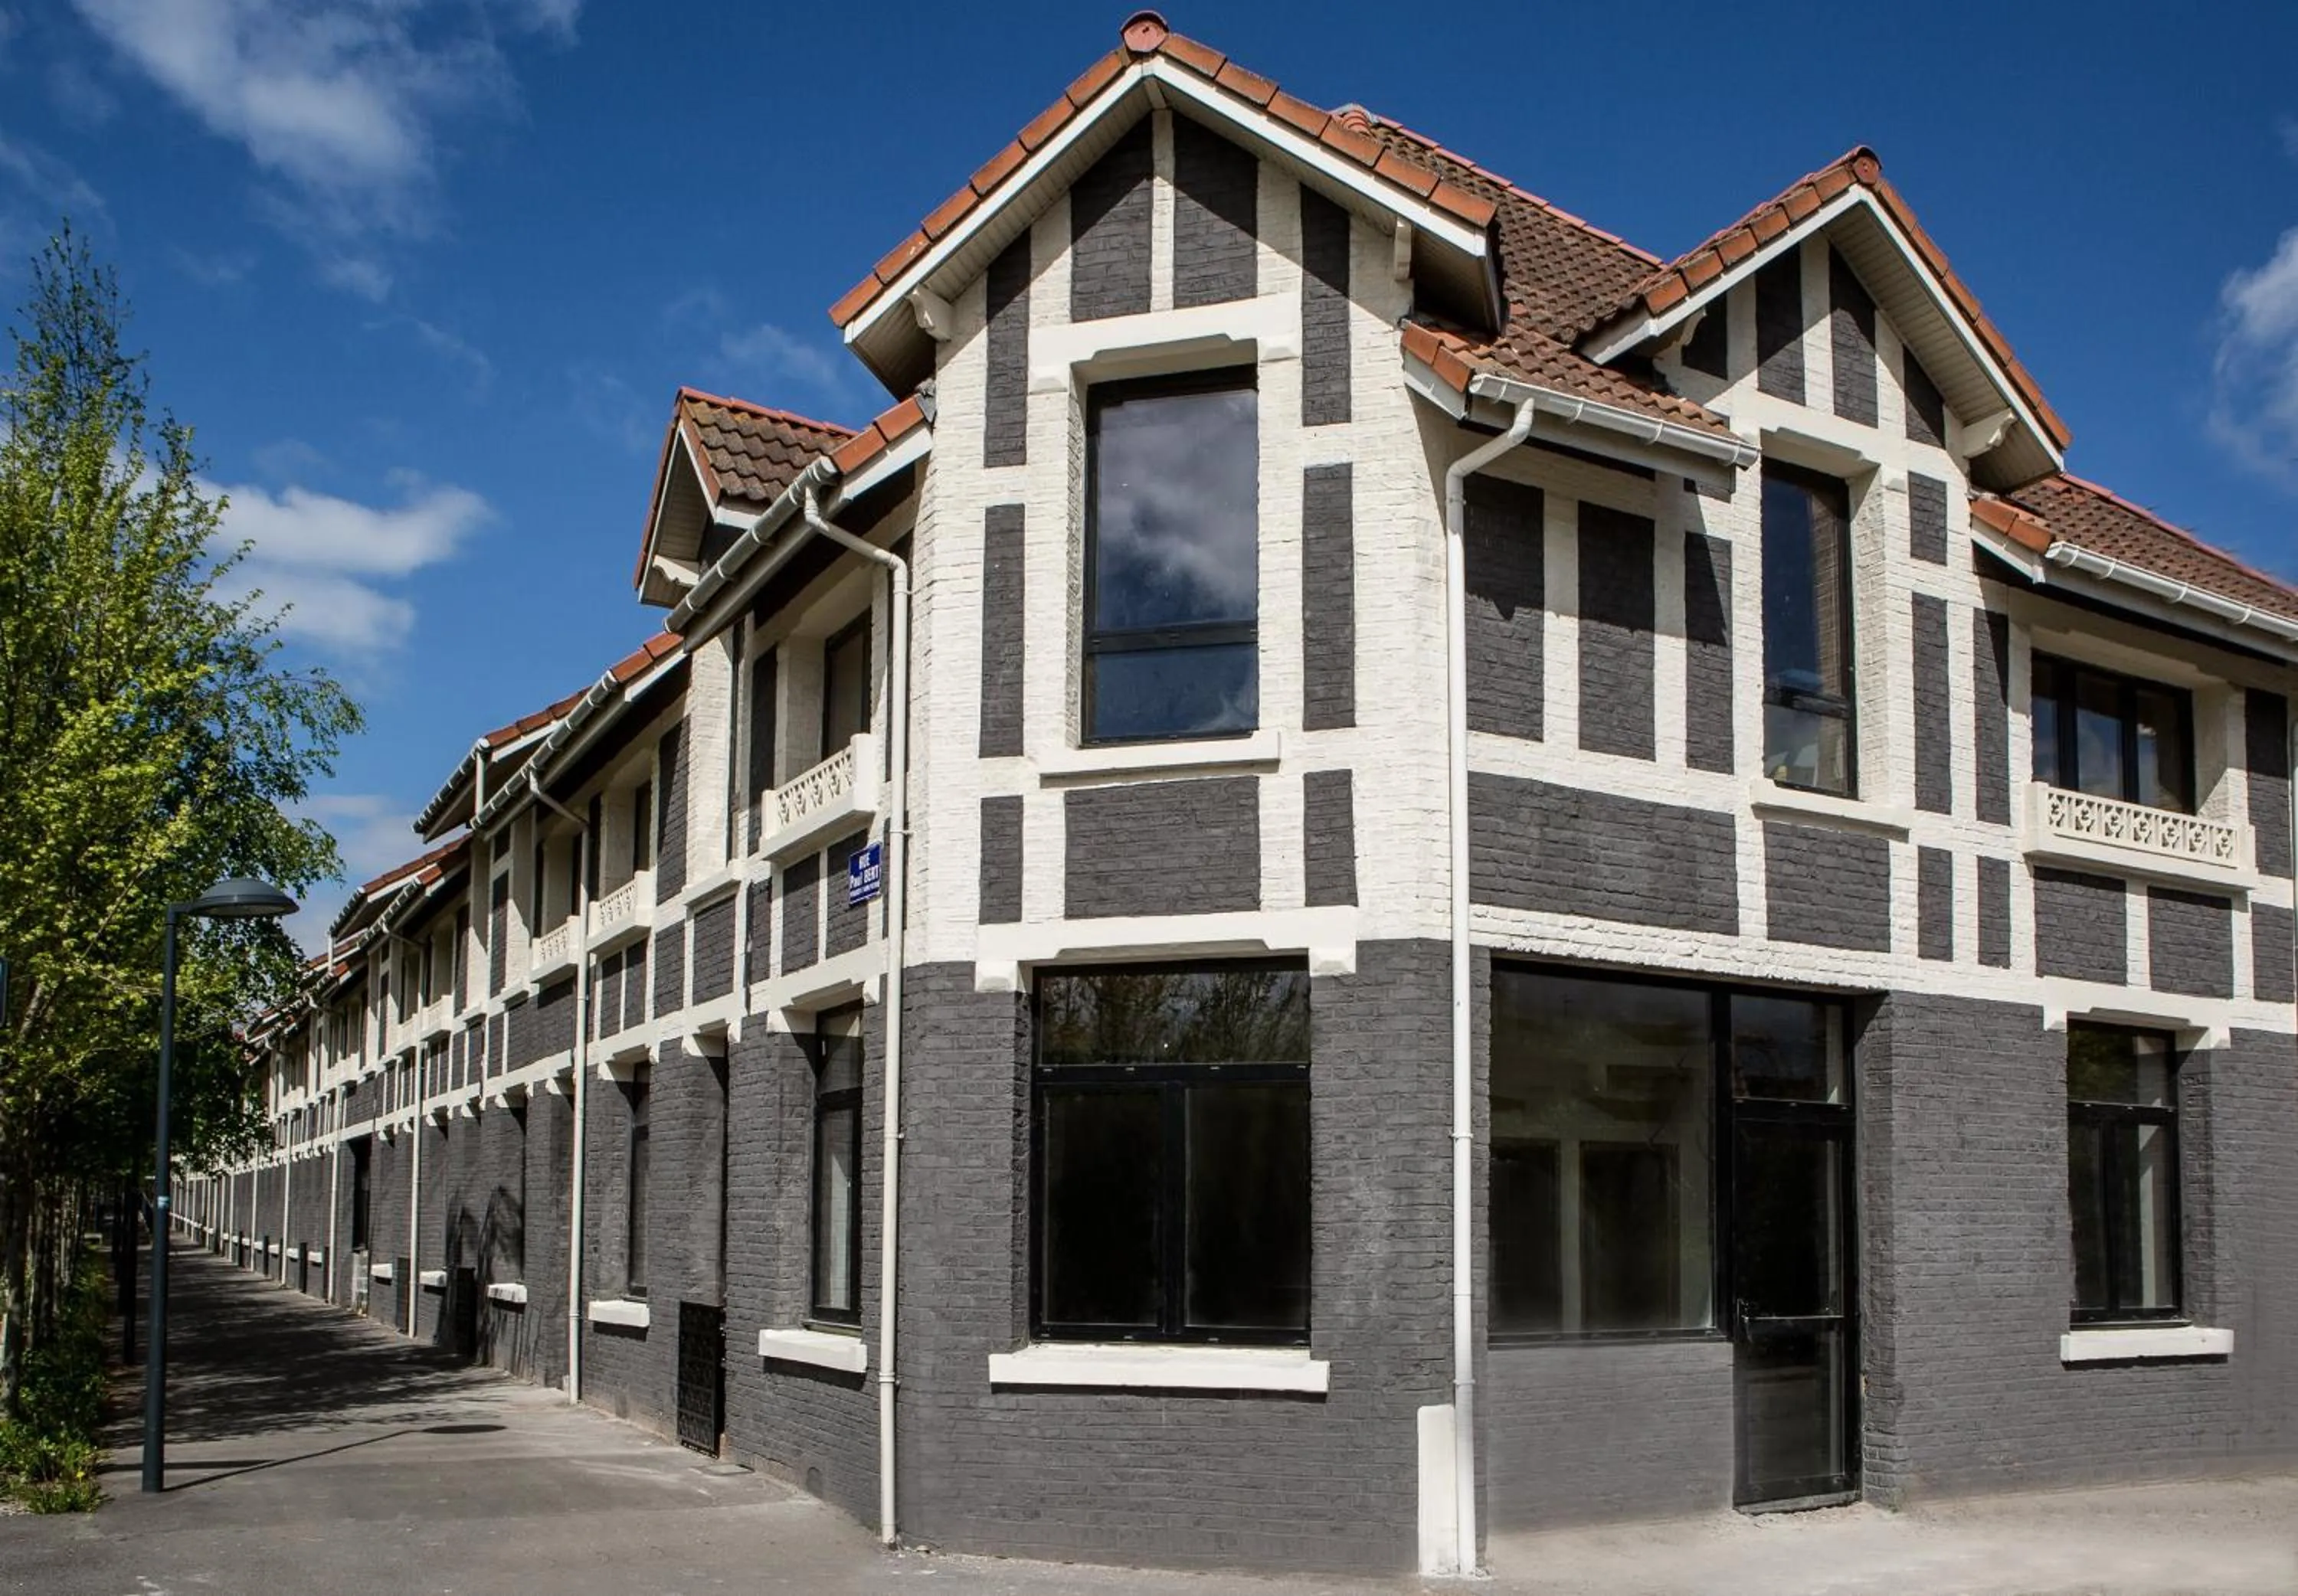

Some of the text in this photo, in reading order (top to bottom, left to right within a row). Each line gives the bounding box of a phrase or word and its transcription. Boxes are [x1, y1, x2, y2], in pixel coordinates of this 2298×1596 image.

[859, 852, 870, 870] RUE
[849, 871, 863, 889] Paul
[864, 865, 879, 883] BERT
